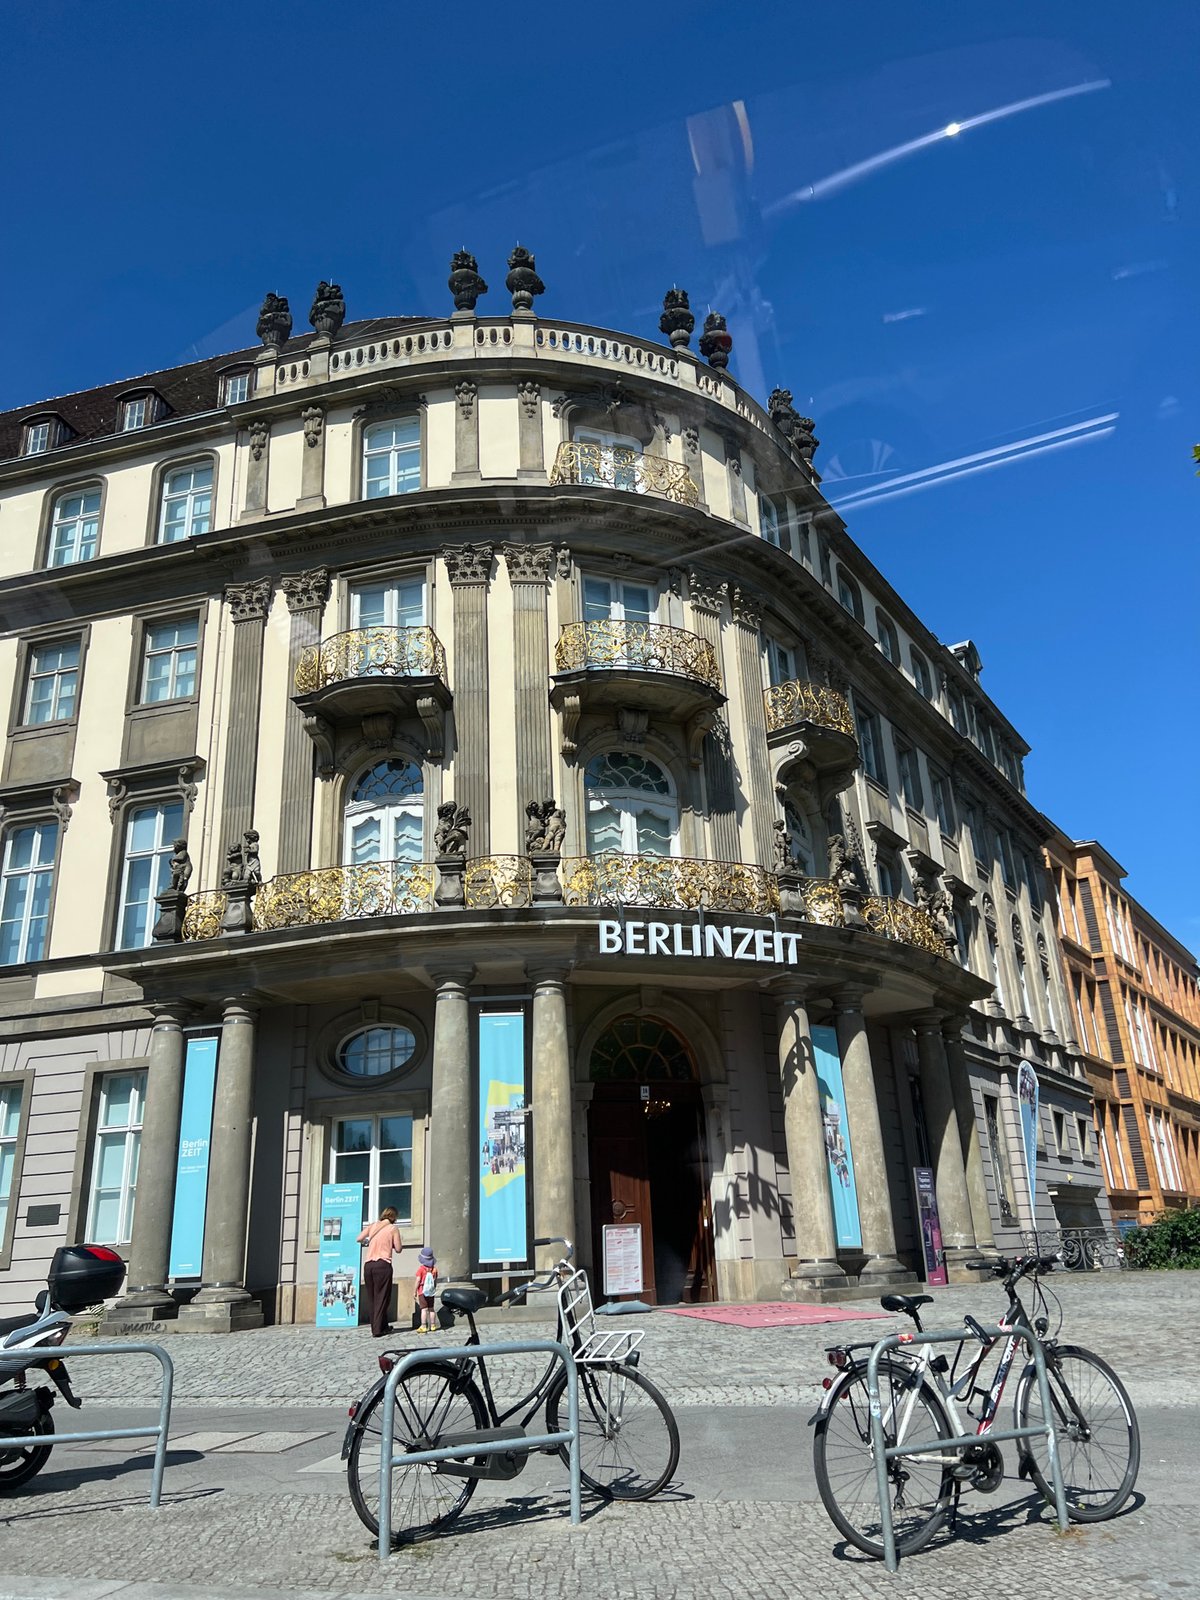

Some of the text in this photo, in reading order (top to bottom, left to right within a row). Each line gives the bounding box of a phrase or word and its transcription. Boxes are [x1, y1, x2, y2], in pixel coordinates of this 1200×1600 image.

[599, 920, 803, 965] BERLINZEIT
[182, 1138, 208, 1148] Berlin
[182, 1148, 202, 1158] ZEIT
